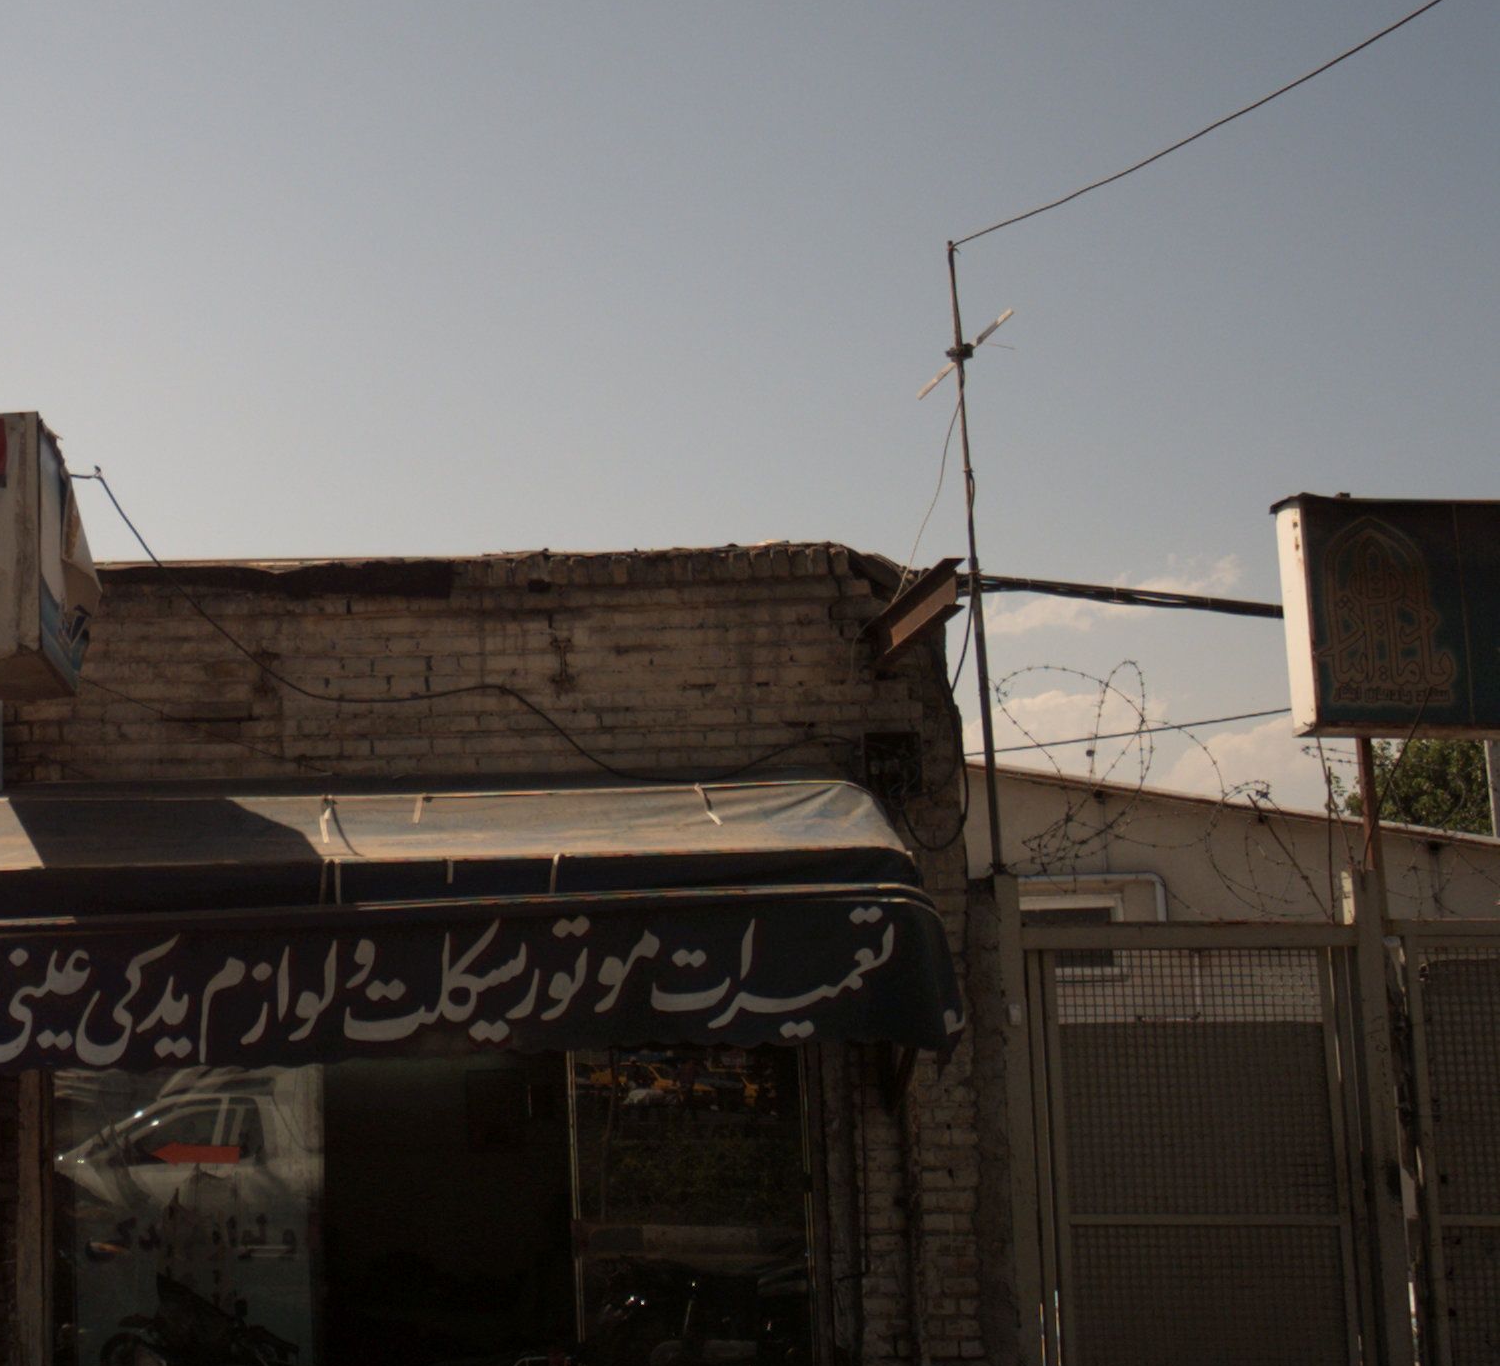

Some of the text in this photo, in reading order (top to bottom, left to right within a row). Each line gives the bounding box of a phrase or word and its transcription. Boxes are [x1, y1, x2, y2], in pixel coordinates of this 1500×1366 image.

[75, 933, 193, 1066] یدکی
[200, 938, 338, 1063] لوازم
[650, 906, 895, 1038] تعمیرات
